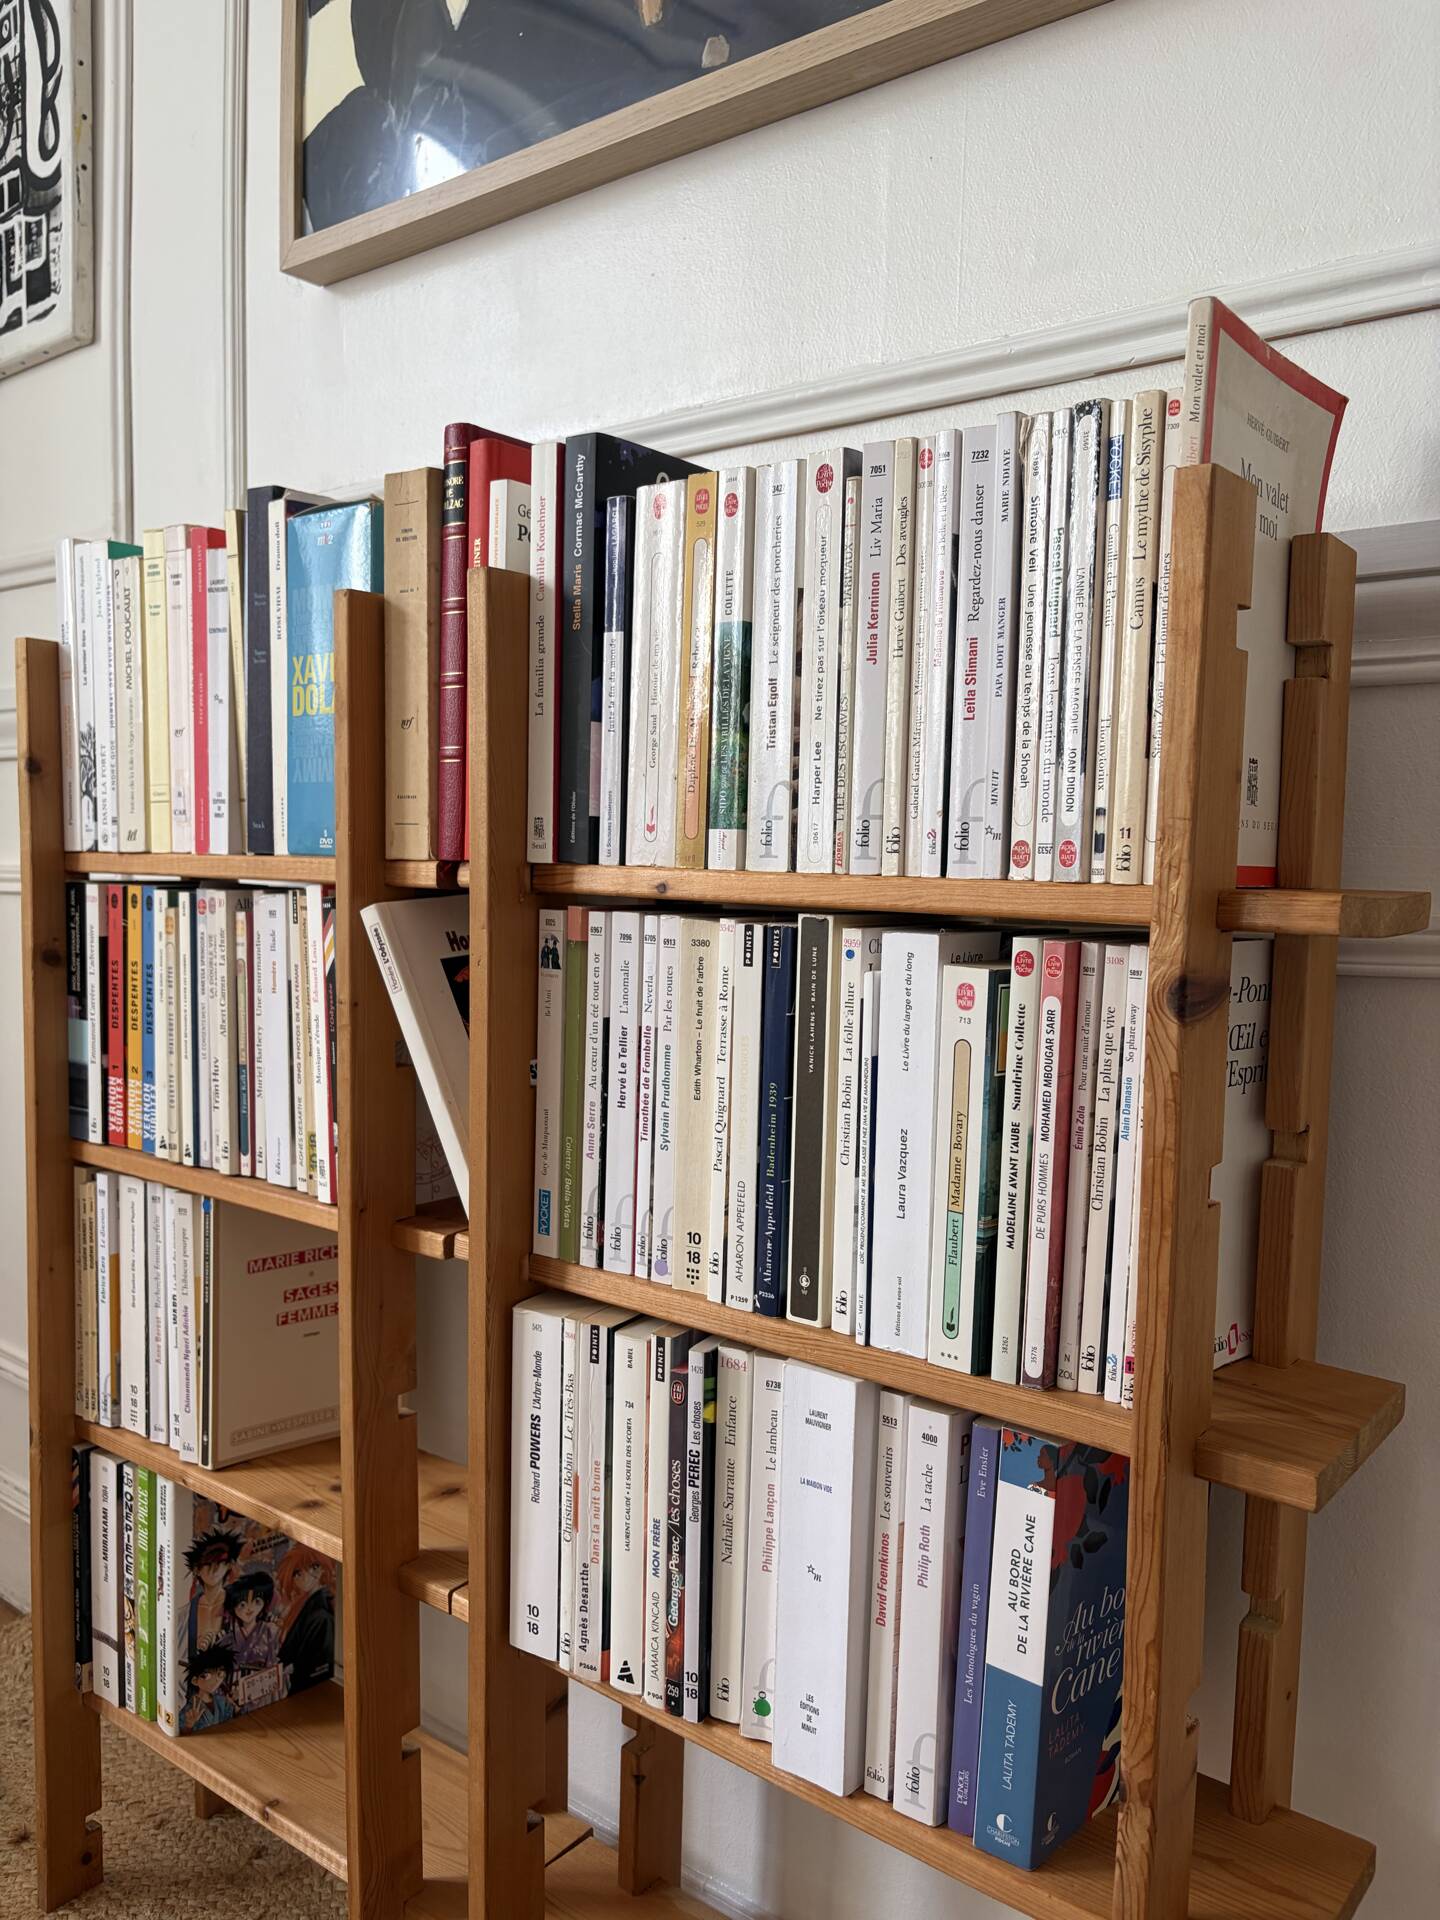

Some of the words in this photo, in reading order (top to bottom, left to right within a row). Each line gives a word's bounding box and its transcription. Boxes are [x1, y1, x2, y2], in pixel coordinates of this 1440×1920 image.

[1136, 408, 1155, 465] Sisyphe
[869, 465, 886, 474] 7051
[972, 450, 989, 462] 7232
[1002, 449, 1010, 486] NDIAYE
[574, 454, 586, 509] McCarthy
[1136, 468, 1150, 486] de
[870, 497, 883, 534] Maria
[897, 496, 909, 541] aveugles
[971, 483, 985, 525] danser
[1001, 490, 1010, 522] MARIE
[1135, 490, 1153, 536] mythe
[537, 496, 547, 552] Kouchner
[574, 512, 584, 557] Cormac
[771, 514, 784, 573] porcheries
[819, 535, 829, 586] moqueur
[870, 538, 882, 558] Liv
[896, 544, 906, 566] Des
[1133, 539, 1147, 560] Le
[535, 557, 545, 602] Camille
[573, 564, 583, 596] Maris
[725, 570, 734, 616] COLETTE
[771, 577, 781, 596] des
[967, 529, 984, 622] Regardez-nous
[124, 587, 132, 645] FOUCAULT
[572, 599, 582, 630] Stella
[816, 590, 826, 632] l'oiseau
[867, 571, 880, 630] Kerninon
[895, 578, 906, 621] Guibert
[1129, 576, 1145, 630] Camus
[537, 615, 545, 654] grande
[770, 598, 781, 648] seigneur
[997, 597, 1006, 639] MANGER
[769, 651, 778, 664] Le
[867, 634, 877, 665] Julia
[893, 625, 904, 658] Hervé
[996, 643, 1005, 669] DOIT
[535, 657, 544, 698] familia
[817, 655, 825, 674] pas
[965, 637, 979, 686] Slimani
[768, 678, 778, 707] Egolf
[815, 677, 824, 701] tirez
[995, 673, 1004, 697] PAPA
[535, 703, 544, 716] La
[814, 706, 823, 720] Ne
[963, 689, 977, 721] Leïla
[650, 715, 658, 738] Sand
[766, 712, 777, 751] Tristan
[649, 740, 658, 768] George
[812, 742, 822, 761] Lee
[1068, 748, 1077, 774] JOAN
[812, 765, 823, 805] Harper
[990, 770, 999, 805] MINUIT
[1065, 776, 1076, 812] DIDION
[760, 820, 773, 846] folio
[593, 966, 600, 979] en
[594, 952, 600, 963] or
[696, 956, 705, 984] l'arbre
[111, 959, 119, 1029] DESPENTES
[591, 981, 600, 1001] tout
[619, 960, 630, 1014] L'anomalie
[695, 986, 704, 997] de
[719, 966, 730, 1001] Rome
[591, 1004, 599, 1018] été
[695, 999, 704, 1017] fruit
[695, 1019, 703, 1030] Le
[1045, 1009, 1056, 1035] SARR
[590, 1021, 599, 1043] d'un
[618, 1025, 629, 1059] Tellier
[717, 1015, 729, 1064] Terrasse
[1014, 1003, 1026, 1050] Collette
[642, 1025, 652, 1073] Fombelle
[694, 1040, 703, 1076] Wharton
[1042, 1038, 1055, 1088] MBOUGAR
[590, 1075, 598, 1090] Au
[618, 1062, 627, 1075] Le
[642, 1077, 651, 1090] de
[661, 1044, 672, 1108] Prudhomme
[1011, 1054, 1024, 1111] Sandrine
[108, 1076, 117, 1132] VERNON
[617, 1077, 627, 1109] Hervé
[693, 1078, 702, 1101] Edith
[715, 1076, 727, 1134] Quignard
[1121, 1077, 1133, 1115] Damasio
[587, 1101, 596, 1129] Serre
[640, 1093, 650, 1142] Timothée
[659, 1112, 670, 1151] Sylvain
[953, 1111, 967, 1151] Bovary
[1040, 1091, 1052, 1142] MOHAMED
[1120, 1117, 1130, 1141] Alain
[586, 1132, 595, 1160] Anne
[712, 1137, 724, 1172] Pascal
[898, 1129, 909, 1180] Vazquez
[1010, 1121, 1020, 1154] L'AUBE
[951, 1157, 962, 1207] Madame
[1008, 1157, 1019, 1188] AVANT
[735, 1180, 746, 1232] APPELFELD
[896, 1184, 907, 1220] Laura
[609, 1227, 622, 1251] folio
[1005, 1192, 1017, 1250] MADELAINE
[734, 1234, 744, 1282] AHARON
[949, 1219, 959, 1266] Flaubert
[249, 1253, 300, 1273] MARIE
[532, 1350, 542, 1410] L'Arbre-Monde
[725, 1395, 737, 1446] Enfance
[766, 1409, 778, 1455] lambeau
[530, 1414, 541, 1470] POWERS
[688, 1449, 701, 1489] PEREC
[765, 1456, 776, 1471] Le
[881, 1446, 893, 1499] souvenirs
[921, 1464, 933, 1494] tache
[978, 1447, 989, 1477] Ensler
[531, 1471, 540, 1503] Richard
[725, 1458, 736, 1511] Sarraute
[689, 1491, 701, 1523] Georges
[763, 1483, 776, 1524] Lançon
[880, 1500, 891, 1520] Les
[920, 1497, 932, 1512] La
[651, 1517, 661, 1546] FRÈRE
[722, 1514, 735, 1565] Nathalie
[919, 1525, 931, 1552] Roth
[1024, 1514, 1036, 1554] CANE
[652, 1549, 660, 1578] MON
[762, 1527, 776, 1573] Philippe
[877, 1532, 890, 1592] Foenkinos
[917, 1554, 932, 1588] Philip
[1009, 1549, 1021, 1588] BORD
[1018, 1558, 1033, 1610] RIVIÈRE
[579, 1562, 589, 1613] Desarthe
[1007, 1591, 1018, 1612] AU
[651, 1591, 660, 1633] KINCAID
[875, 1594, 887, 1627] David
[1018, 1613, 1029, 1631] LA
[578, 1617, 589, 1652] Agnès
[1017, 1635, 1027, 1655] DE
[650, 1637, 659, 1681] JAMAICA
[1005, 1699, 1017, 1748] TADEMY
[1001, 1752, 1014, 1790] LALITA
